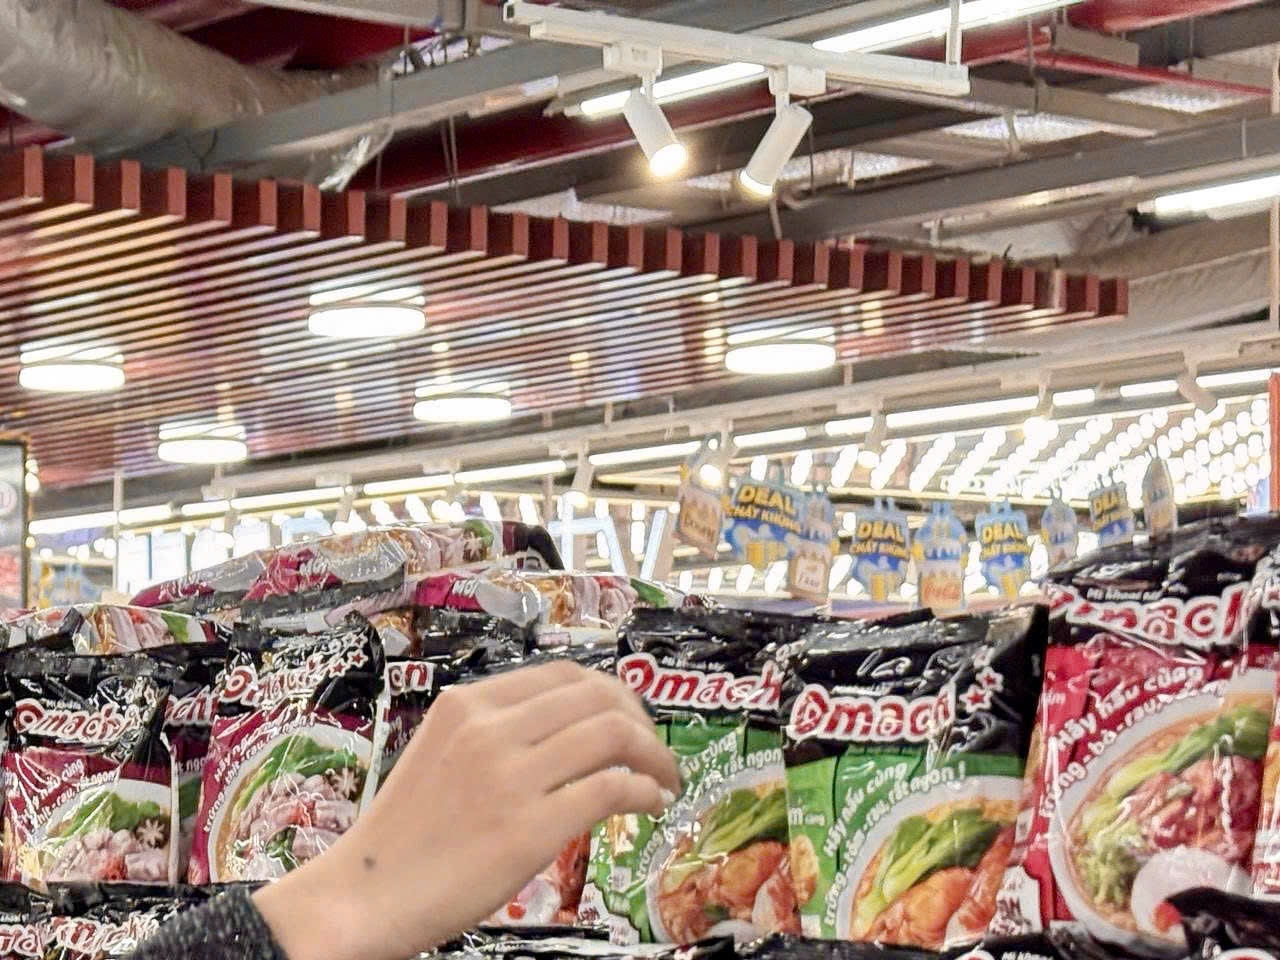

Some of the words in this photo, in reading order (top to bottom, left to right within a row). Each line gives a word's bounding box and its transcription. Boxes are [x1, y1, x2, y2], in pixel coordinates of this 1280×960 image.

[738, 484, 796, 514] DEAL
[857, 518, 905, 543] DEAL
[982, 522, 1024, 546] DEAL
[617, 651, 785, 712] Omach
